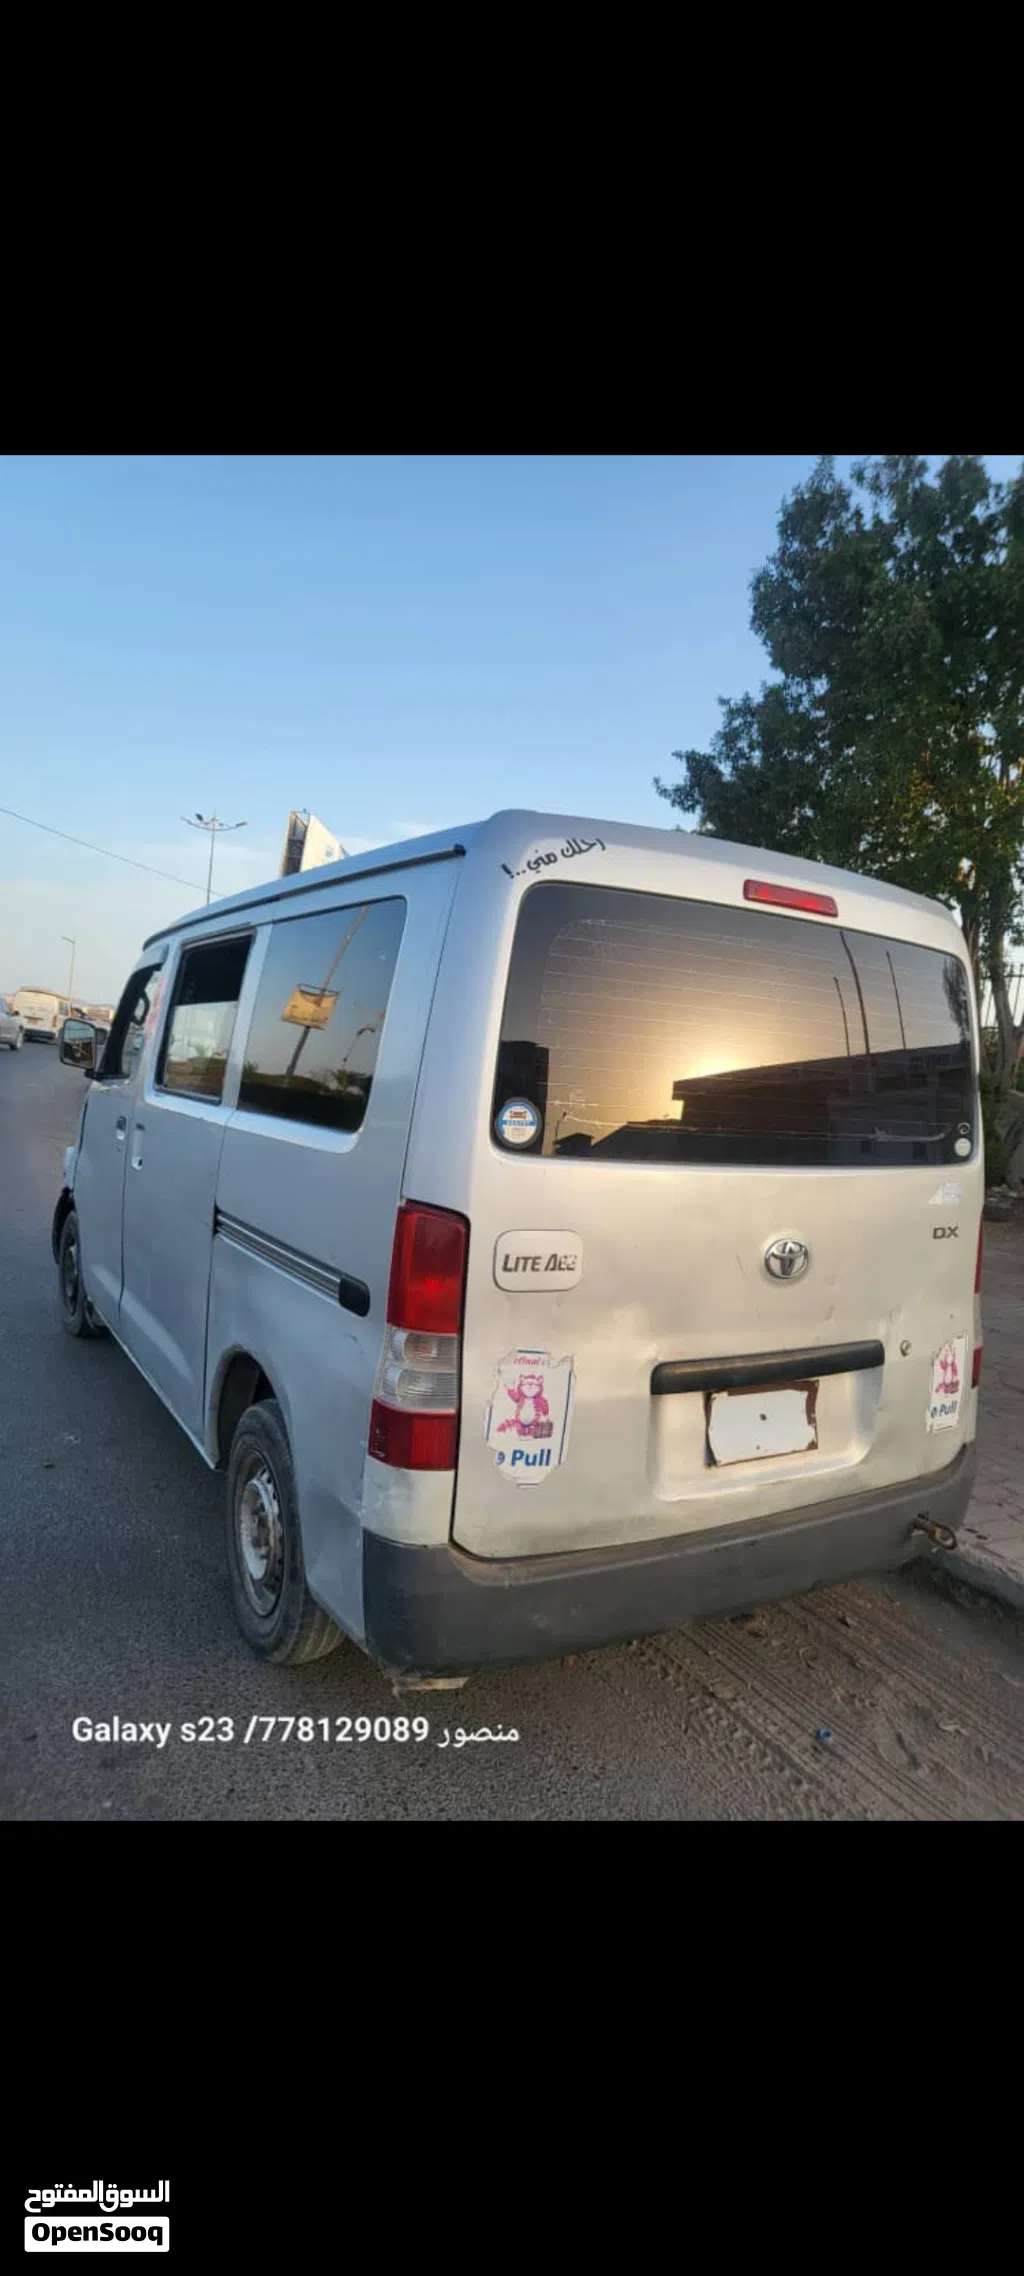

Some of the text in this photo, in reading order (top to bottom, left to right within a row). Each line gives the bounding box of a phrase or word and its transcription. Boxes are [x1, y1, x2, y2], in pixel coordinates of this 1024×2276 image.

[932, 1225, 959, 1240] DX
[502, 1254, 542, 1273] LITE
[511, 1448, 552, 1467] Pull
